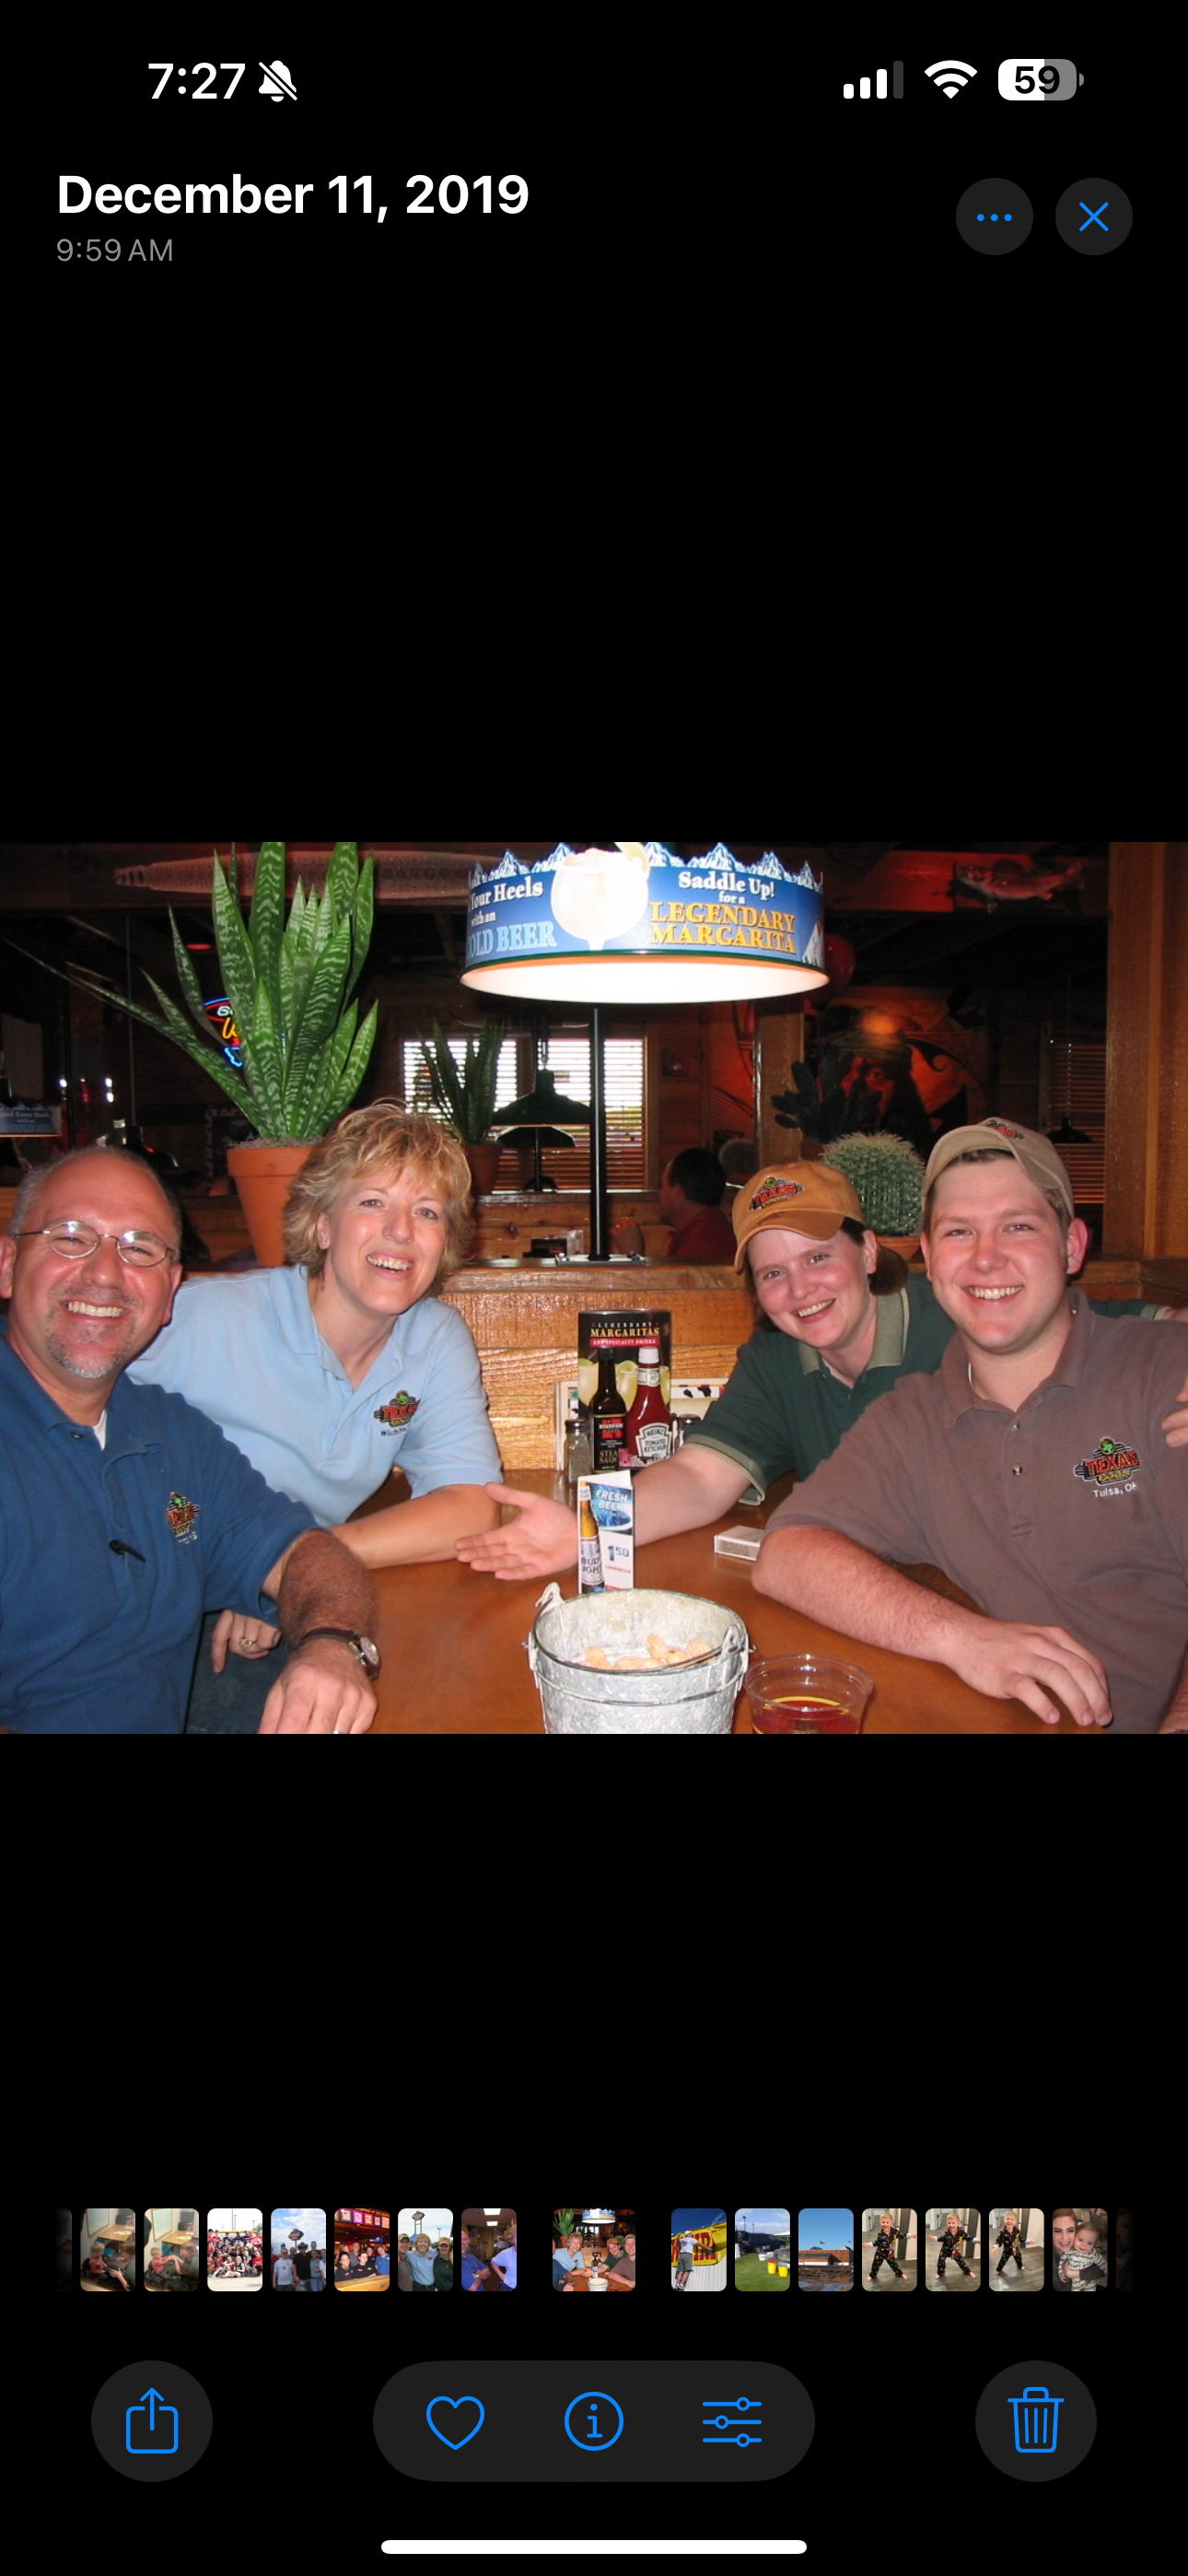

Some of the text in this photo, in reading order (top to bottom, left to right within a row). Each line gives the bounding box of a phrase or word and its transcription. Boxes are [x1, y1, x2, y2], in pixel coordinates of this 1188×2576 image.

[493, 875, 544, 904] Heels
[678, 871, 775, 901] Saddle Up!
[718, 891, 746, 905] for a
[485, 911, 496, 923] an
[650, 901, 797, 934] LEGENDARY
[467, 920, 558, 959] OLD BEER
[649, 922, 797, 954] MARGARITA
[590, 1328, 660, 1338] MARGARITAS
[646, 1428, 665, 1436] HEINZ
[644, 1444, 668, 1453] KETCHUP
[645, 1438, 667, 1446] TOMATO
[1087, 1450, 1138, 1476] TEXAS
[595, 1489, 628, 1503] FRESH
[1092, 1486, 1124, 1498] Tulsa,
[598, 1500, 624, 1512] BEER
[581, 1557, 600, 1565] BUD
